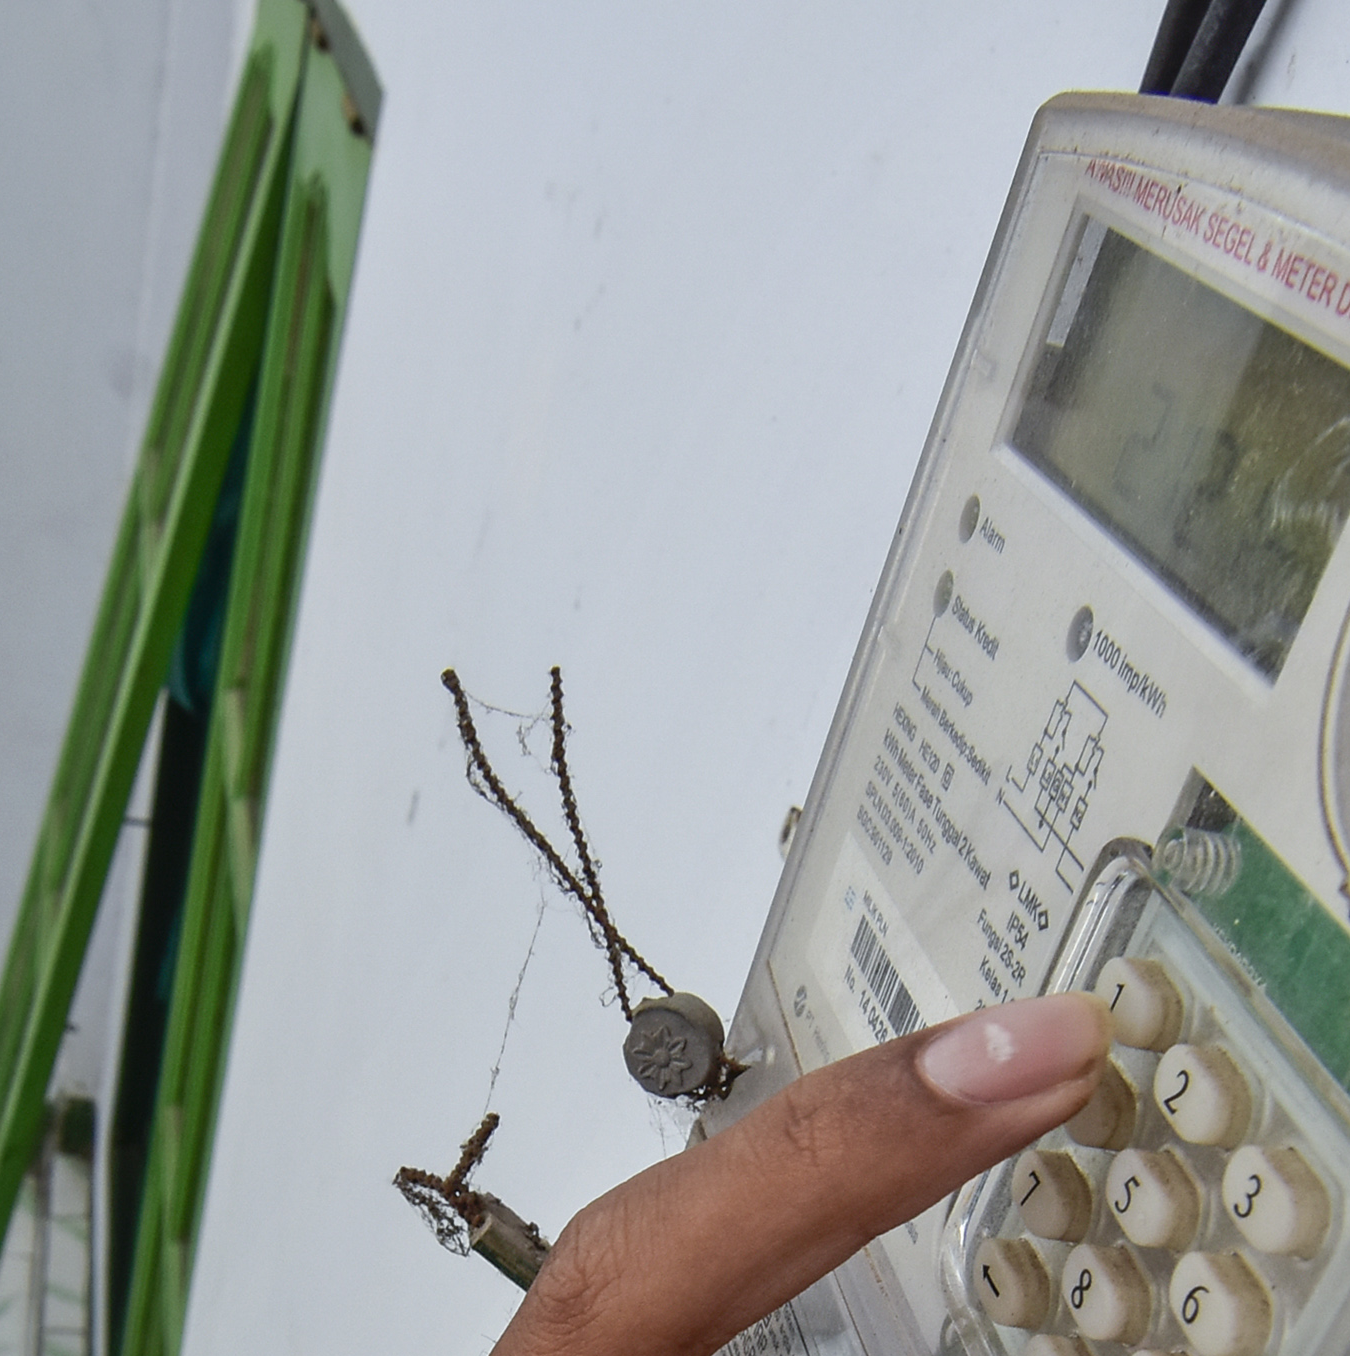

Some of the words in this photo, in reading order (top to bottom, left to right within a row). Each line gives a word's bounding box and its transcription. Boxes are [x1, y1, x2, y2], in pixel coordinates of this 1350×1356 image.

[1133, 175, 1207, 235] MERUSAK
[1203, 212, 1256, 265] SEGEL
[1257, 240, 1273, 272] &
[1271, 247, 1338, 308] METER
[979, 516, 1006, 554] Alarm
[951, 594, 976, 634] Status
[974, 621, 1000, 661] Kredit
[951, 670, 973, 709] Cukup
[1094, 629, 1122, 670] 1000
[1118, 653, 1168, 719] imp/kWh
[883, 728, 901, 759] kWh
[893, 701, 917, 742] HEXING
[918, 738, 941, 774] HE120
[897, 747, 918, 785] Meter
[873, 755, 894, 787] 230V
[916, 818, 937, 854] 50Hz
[914, 773, 934, 810] Fase
[932, 796, 964, 847] Tunggal
[958, 836, 969, 857] 2
[963, 842, 992, 891] Kawat
[1018, 880, 1043, 922] LMK
[1006, 911, 1029, 950] IP54
[979, 955, 1004, 998] Kelas
[999, 943, 1027, 988] 2S-2R
[1109, 983, 1126, 1012] 1
[1163, 1069, 1190, 1114] 2
[1020, 1170, 1041, 1206] 7
[1114, 1175, 1141, 1214] 5
[1233, 1173, 1262, 1219] 3
[1070, 1268, 1093, 1310] 8
[1181, 1285, 1209, 1324] 6
